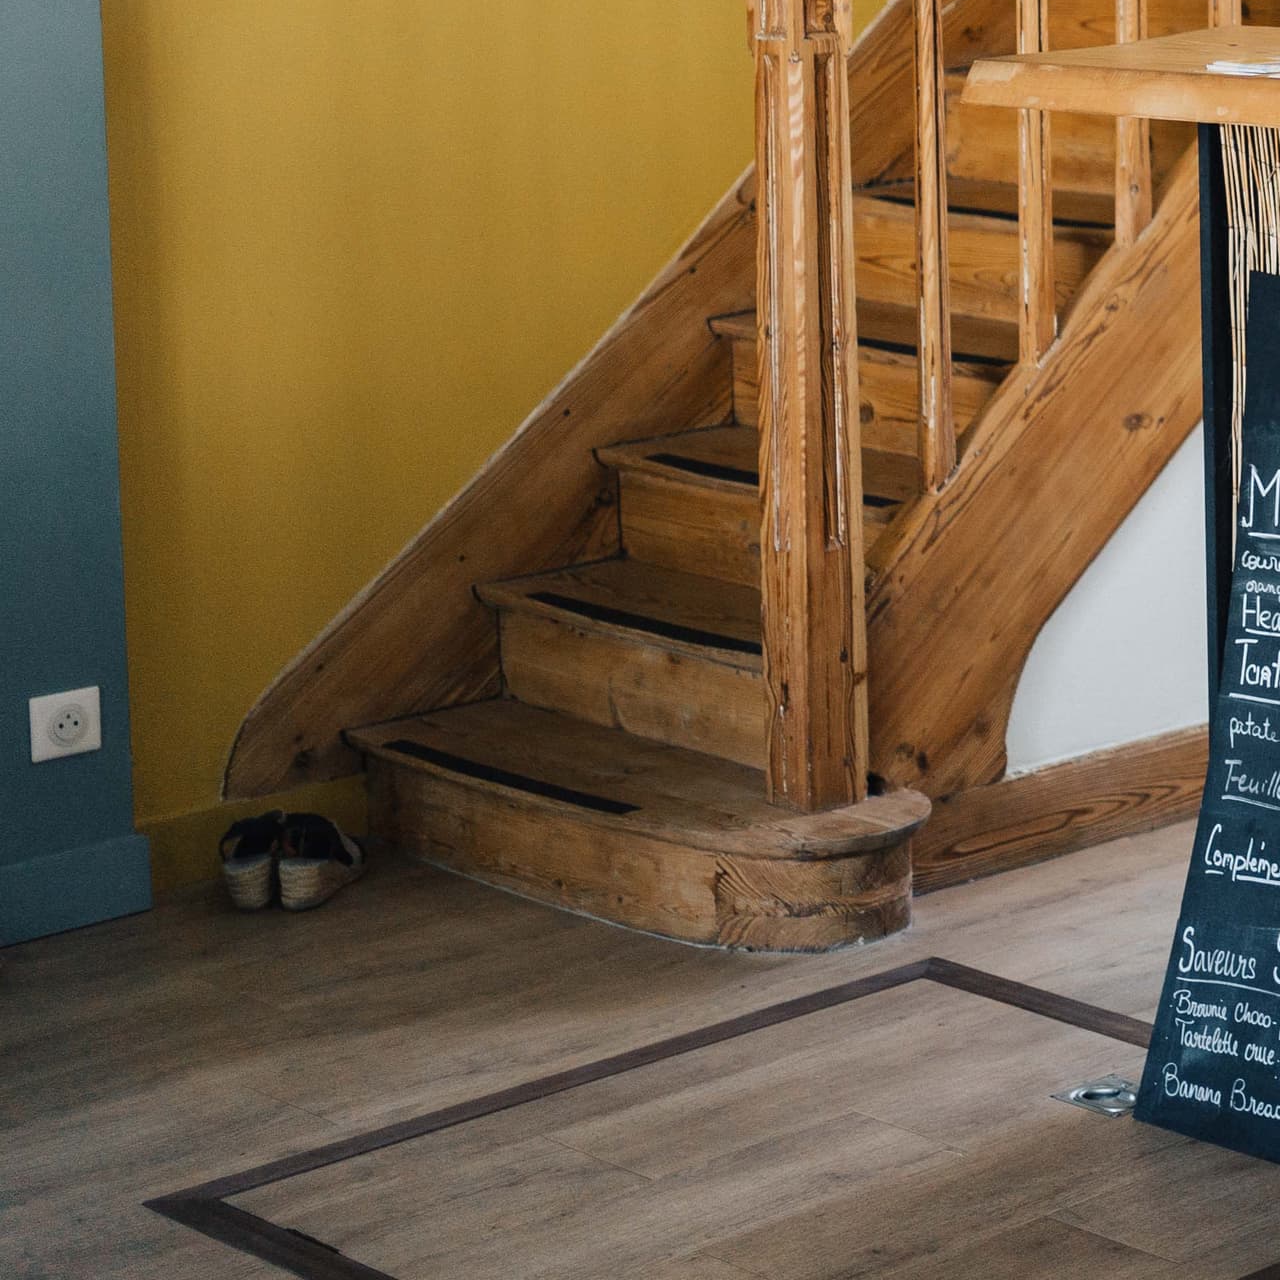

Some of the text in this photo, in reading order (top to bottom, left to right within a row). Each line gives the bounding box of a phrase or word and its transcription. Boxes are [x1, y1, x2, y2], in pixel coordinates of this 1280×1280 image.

[1229, 712, 1280, 749] patate
[1179, 926, 1257, 980] Saveurs
[1173, 989, 1228, 1021] Brownie
[1175, 1018, 1239, 1057] Tartelette
[1244, 1042, 1275, 1065] crue
[1162, 1062, 1222, 1106] Banana
